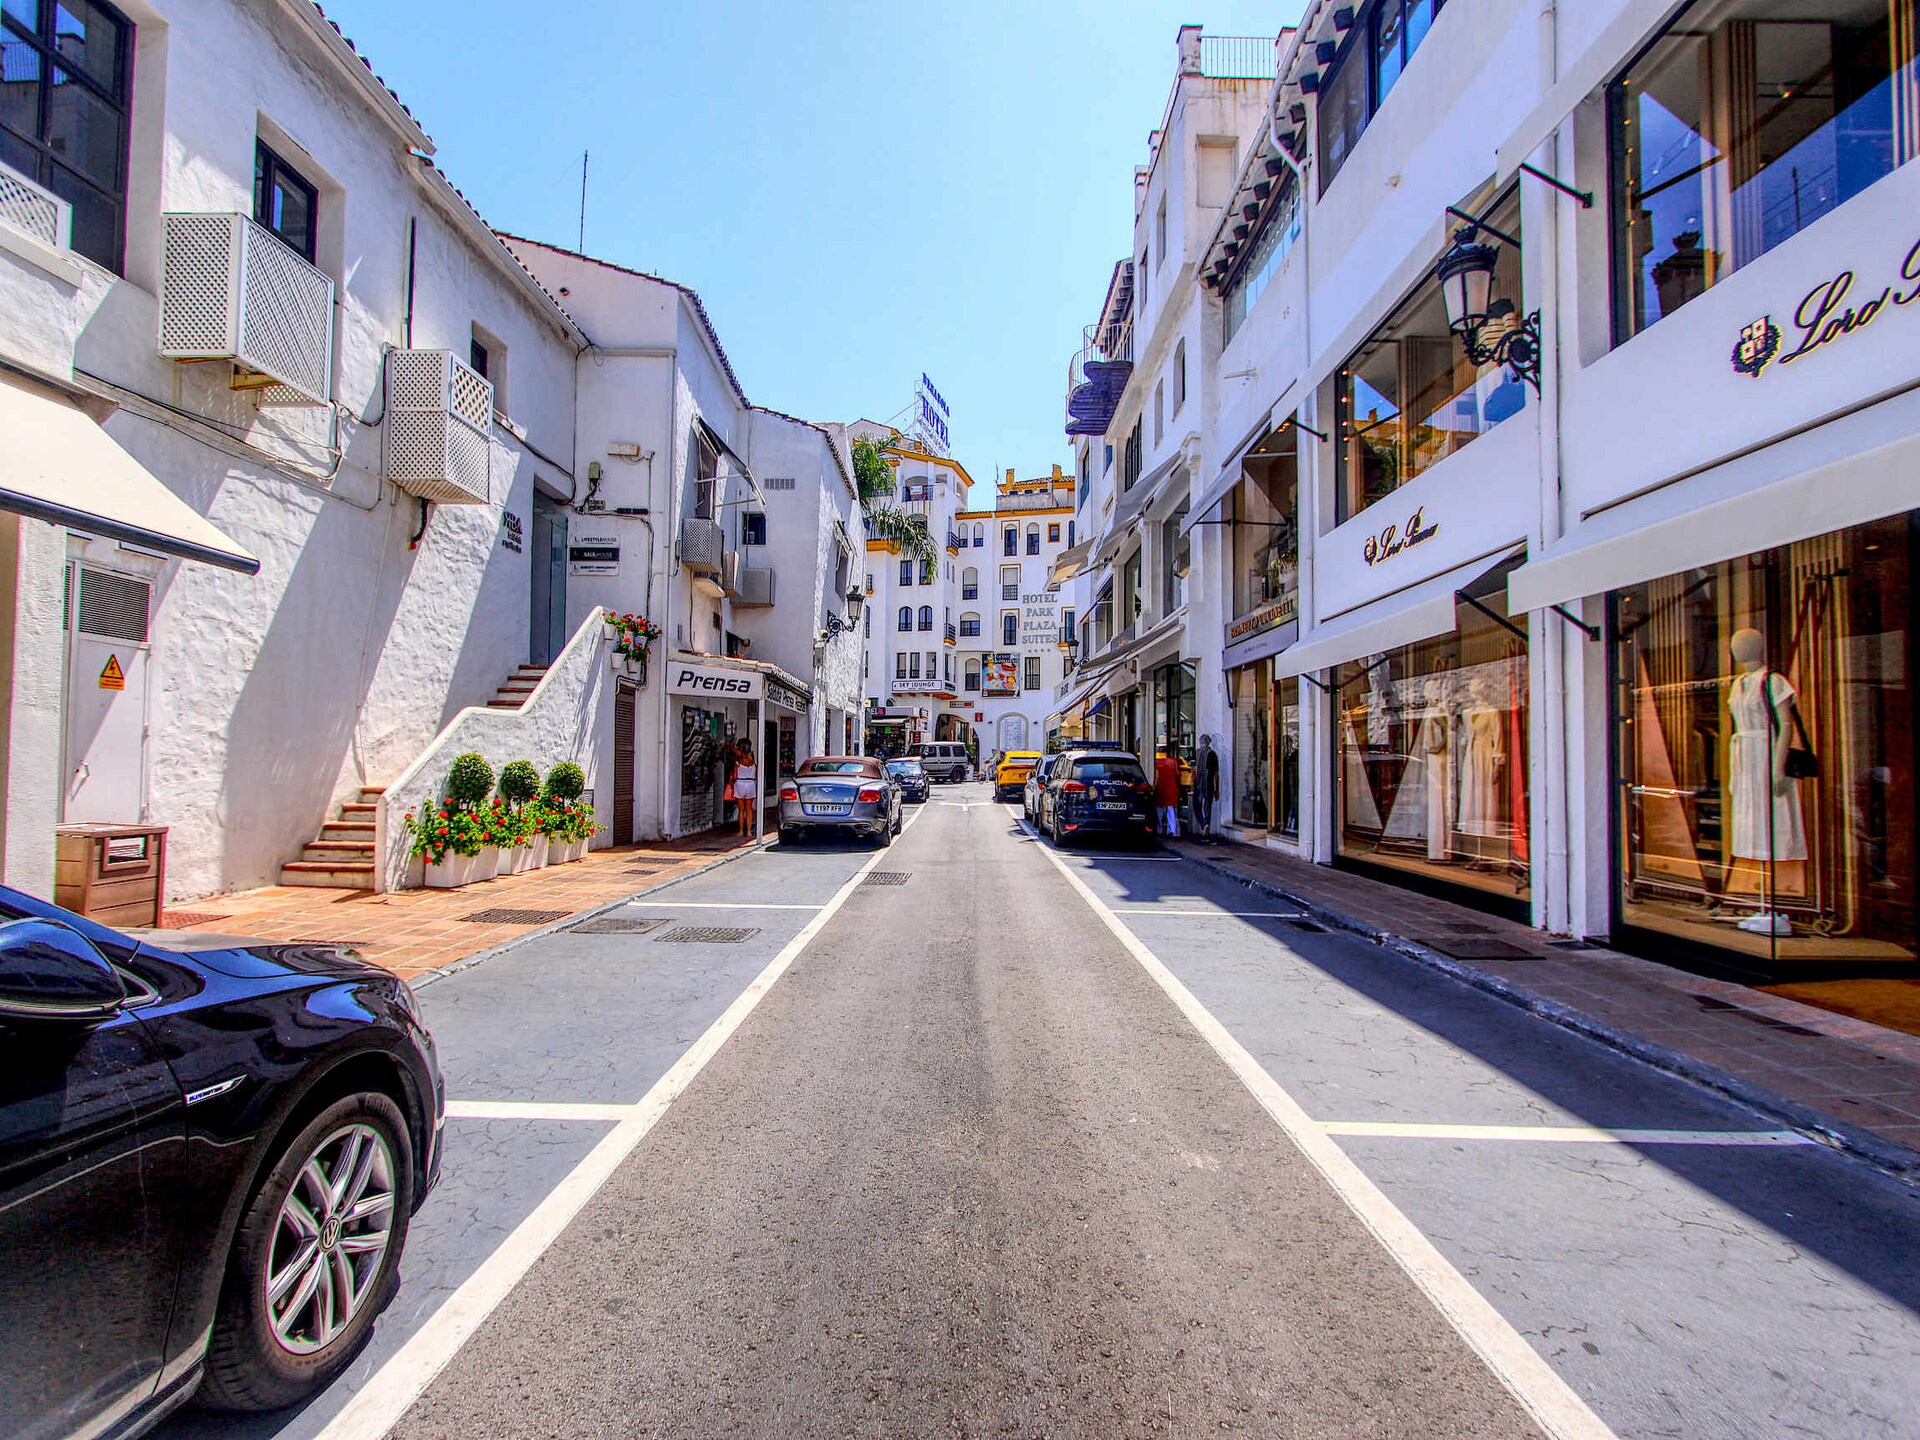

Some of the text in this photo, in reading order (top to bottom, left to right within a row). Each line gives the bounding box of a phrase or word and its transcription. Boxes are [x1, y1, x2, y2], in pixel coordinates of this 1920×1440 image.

[1779, 270, 1892, 364] Loro
[922, 395, 950, 448] HOTEL
[1022, 594, 1058, 604] HOTEL
[1026, 607, 1055, 617] PARK
[1023, 621, 1057, 631] PLAZA
[1021, 634, 1058, 645] SUITES
[677, 670, 752, 693] Prensa
